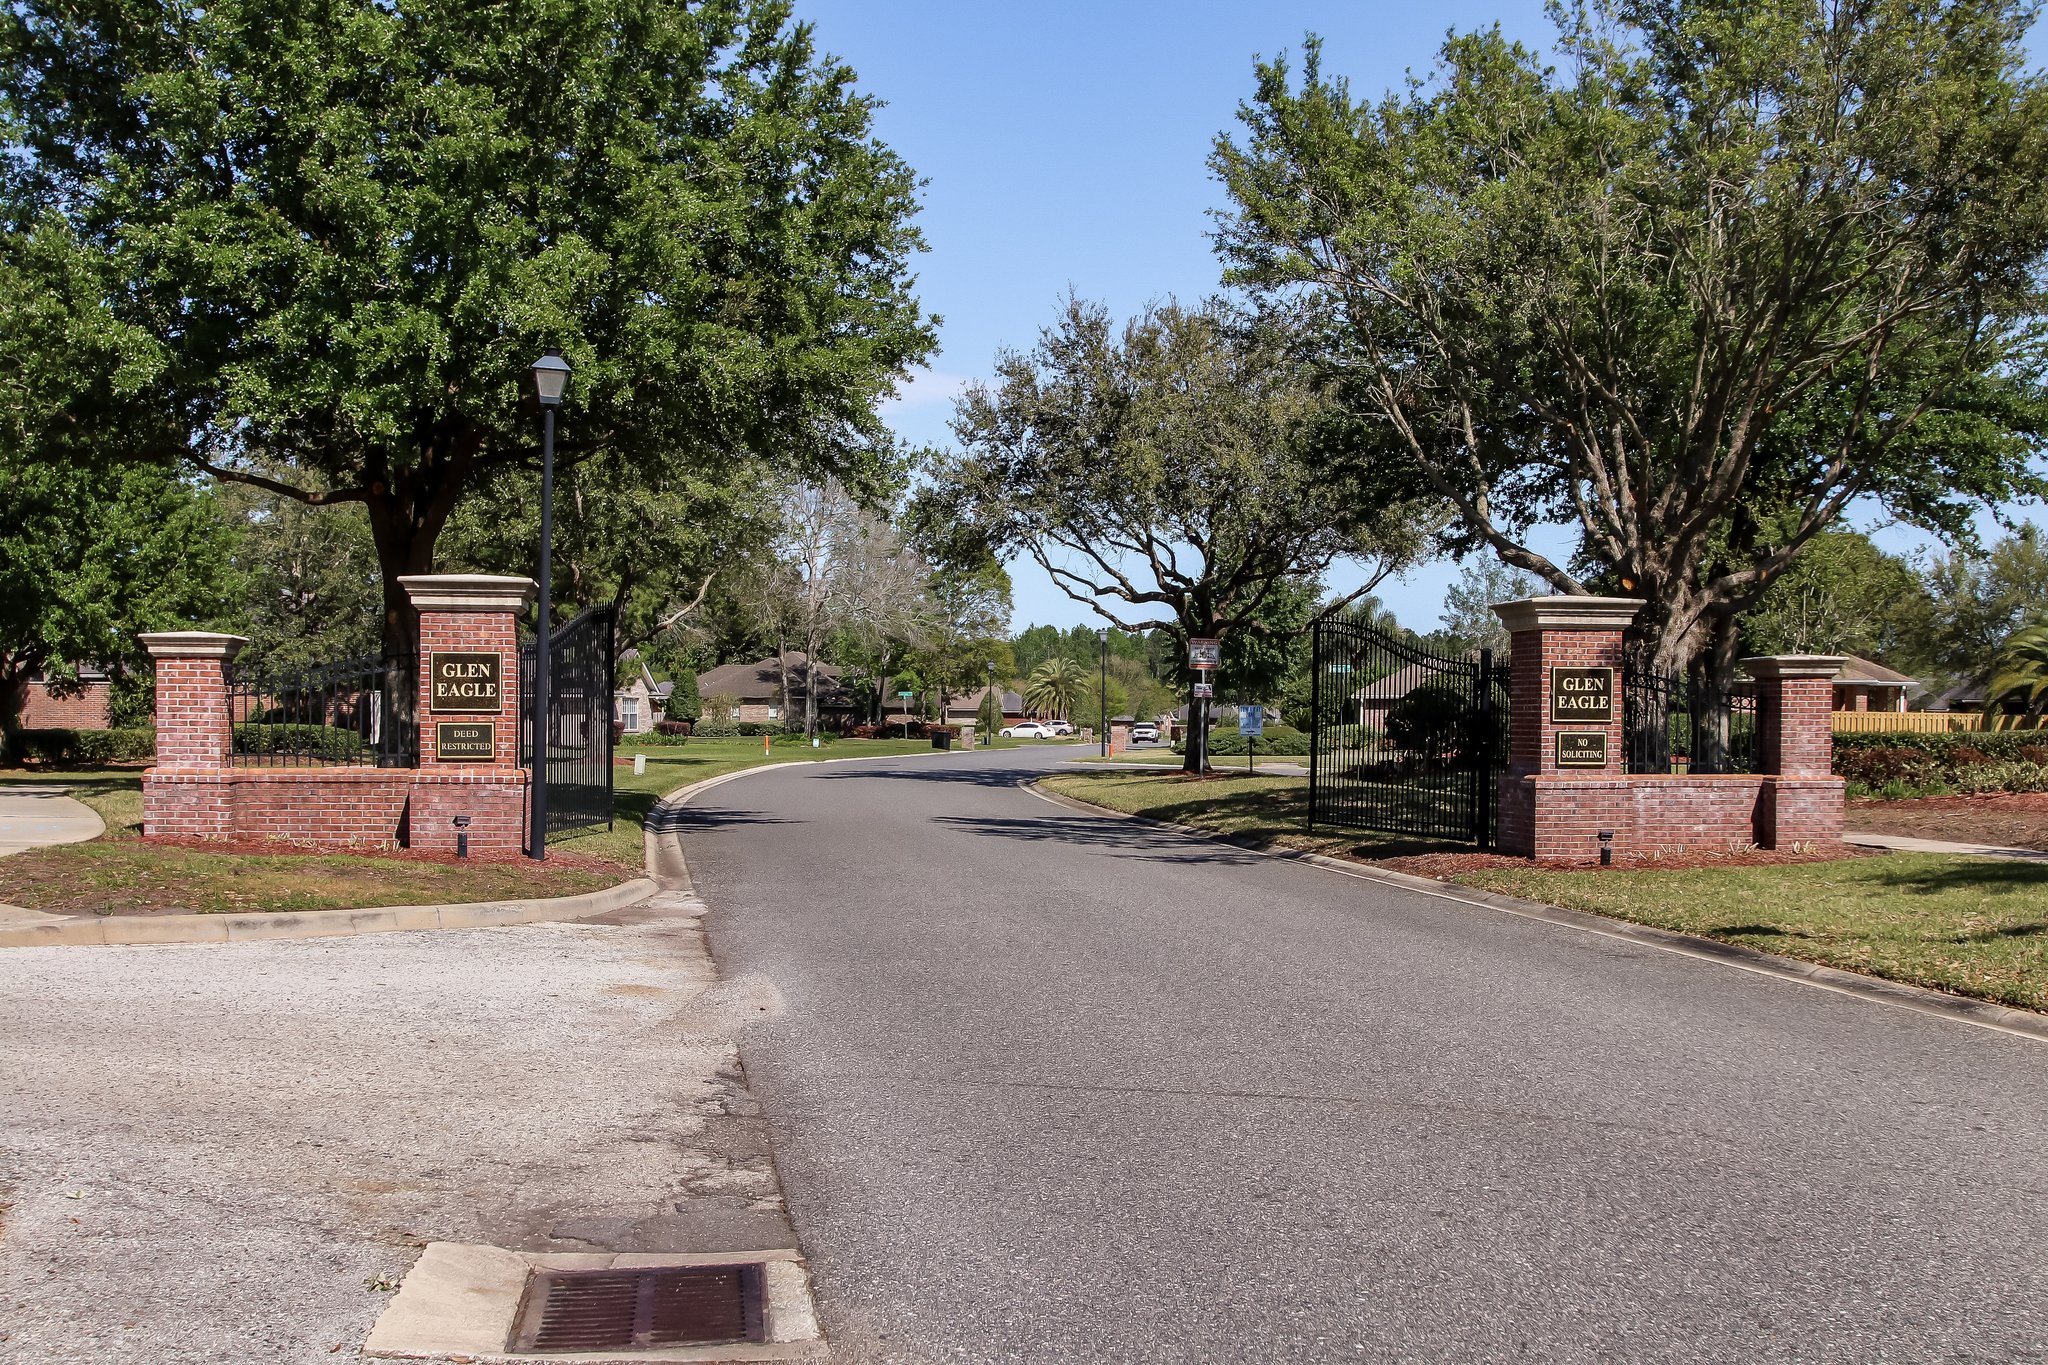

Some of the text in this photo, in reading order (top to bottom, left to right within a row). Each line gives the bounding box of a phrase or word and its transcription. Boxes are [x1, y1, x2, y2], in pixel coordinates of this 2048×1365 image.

[442, 663, 491, 677] GLEN
[1562, 677, 1604, 691] GLEN
[436, 683, 496, 697] EAGLE
[1557, 696, 1609, 709] EAGLE
[453, 730, 479, 738] DEED
[441, 742, 491, 750] RESTRICTED
[1577, 739, 1588, 747] NO
[1561, 750, 1603, 758] SOLICITING
